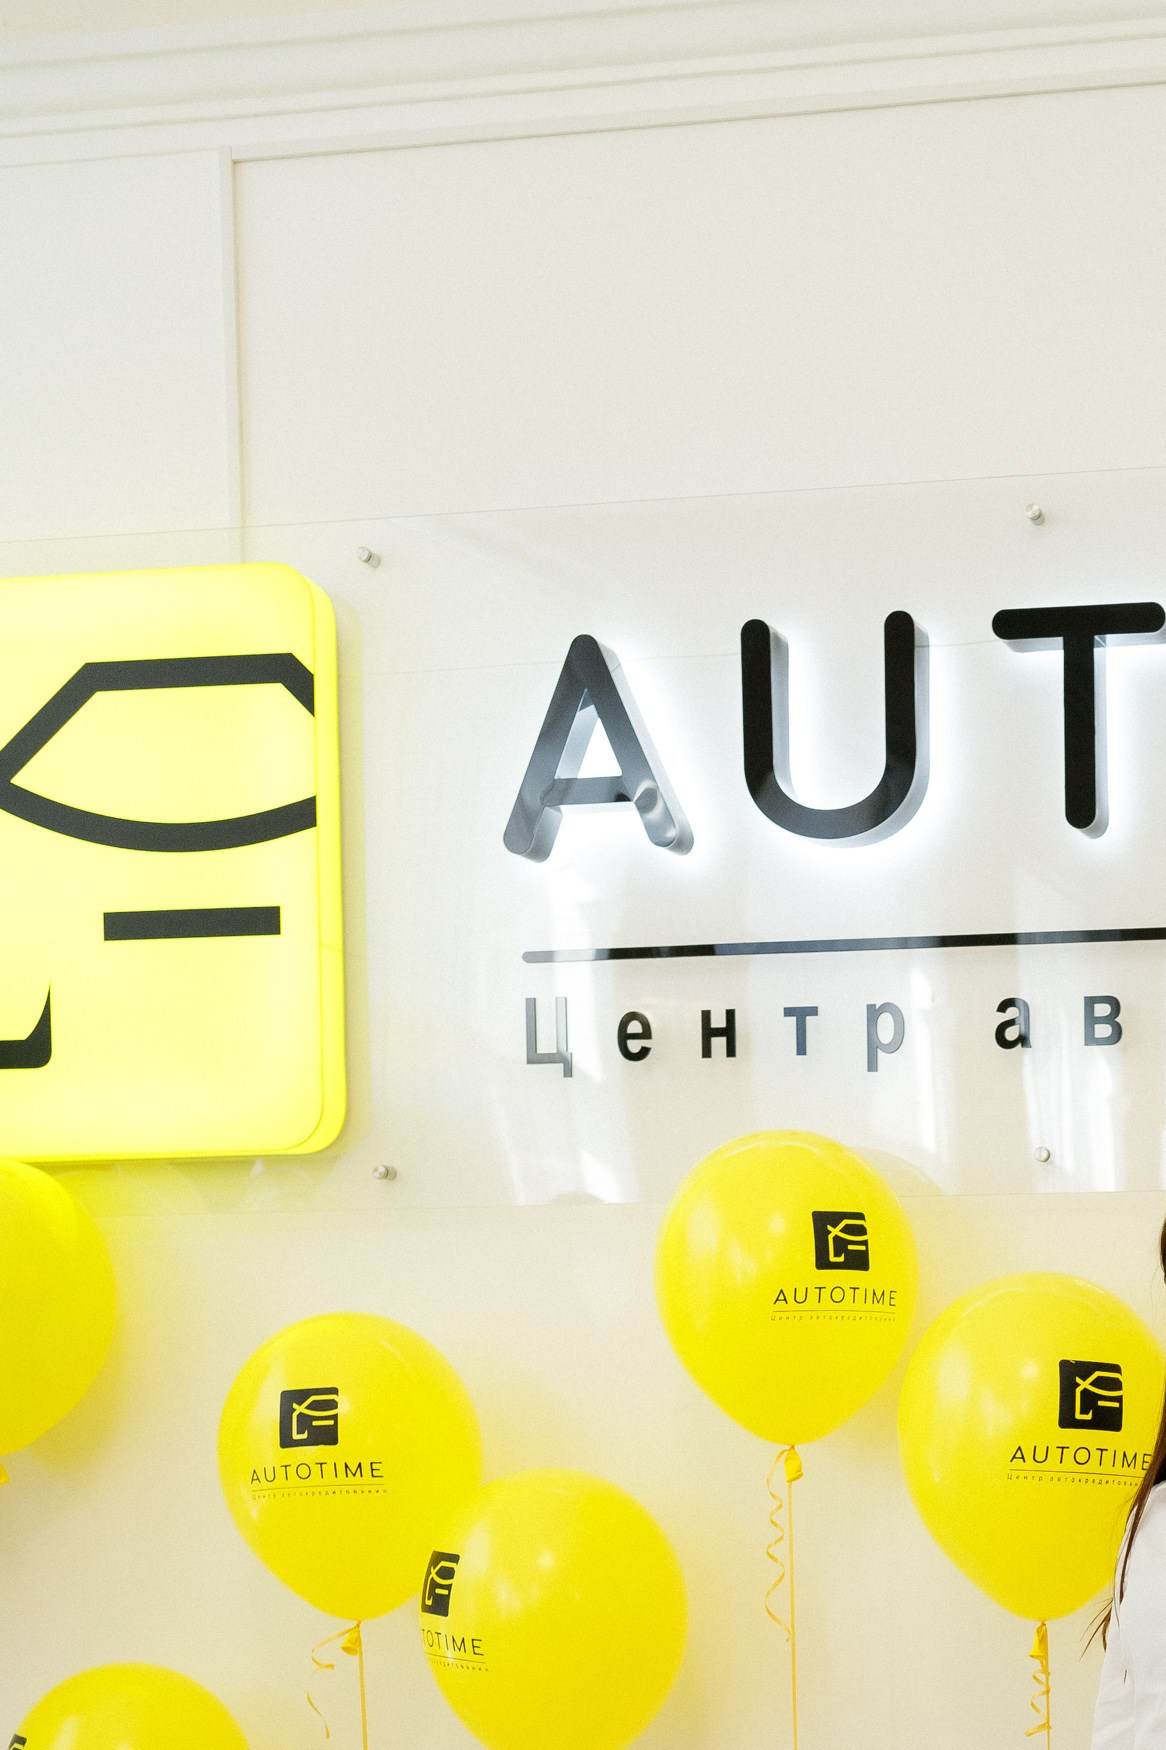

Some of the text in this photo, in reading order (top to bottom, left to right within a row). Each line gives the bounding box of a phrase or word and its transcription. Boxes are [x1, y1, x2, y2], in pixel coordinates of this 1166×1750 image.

[525, 995, 906, 1078] Центр
[773, 1286, 897, 1307] AUTOTIME
[1010, 1445, 1153, 1471] AUTOTIME
[250, 1461, 384, 1485] AUTOTIME
[421, 1628, 485, 1657] TOTIME
